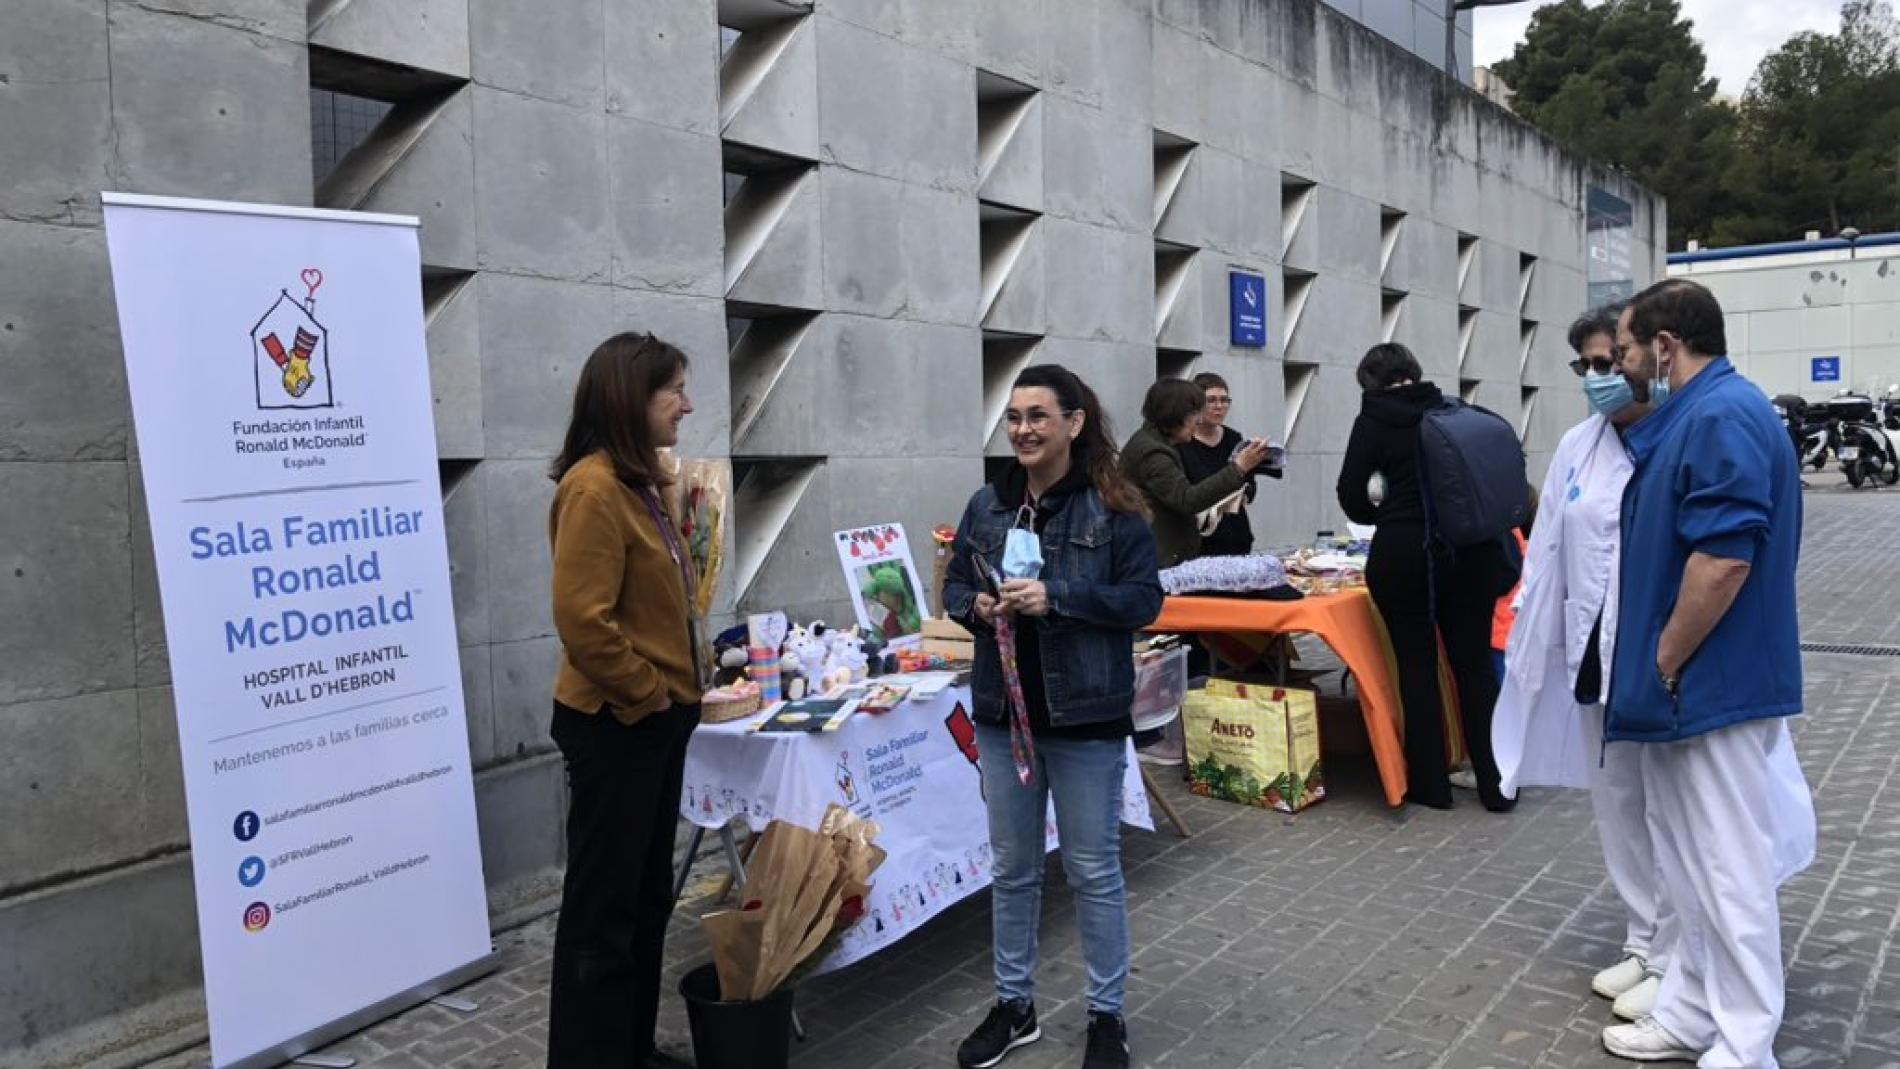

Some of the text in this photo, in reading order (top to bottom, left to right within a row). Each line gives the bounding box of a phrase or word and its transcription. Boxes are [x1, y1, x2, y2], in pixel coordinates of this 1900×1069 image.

[233, 415, 364, 435] Fundación Infantil
[235, 433, 365, 454] Ronald McDonald
[283, 455, 326, 469] España
[190, 507, 423, 560] Sala Familiar
[252, 551, 381, 599] Ronald
[225, 592, 415, 653] McDonald
[243, 644, 408, 690] HOSPITAL INFANTIL
[260, 668, 396, 709] VALL D'HEBRON
[213, 705, 449, 775] Mantenemos a las familias cerca
[866, 730, 928, 761] Sala Familiar
[869, 753, 905, 778] Ronald
[872, 766, 922, 794] McDonald
